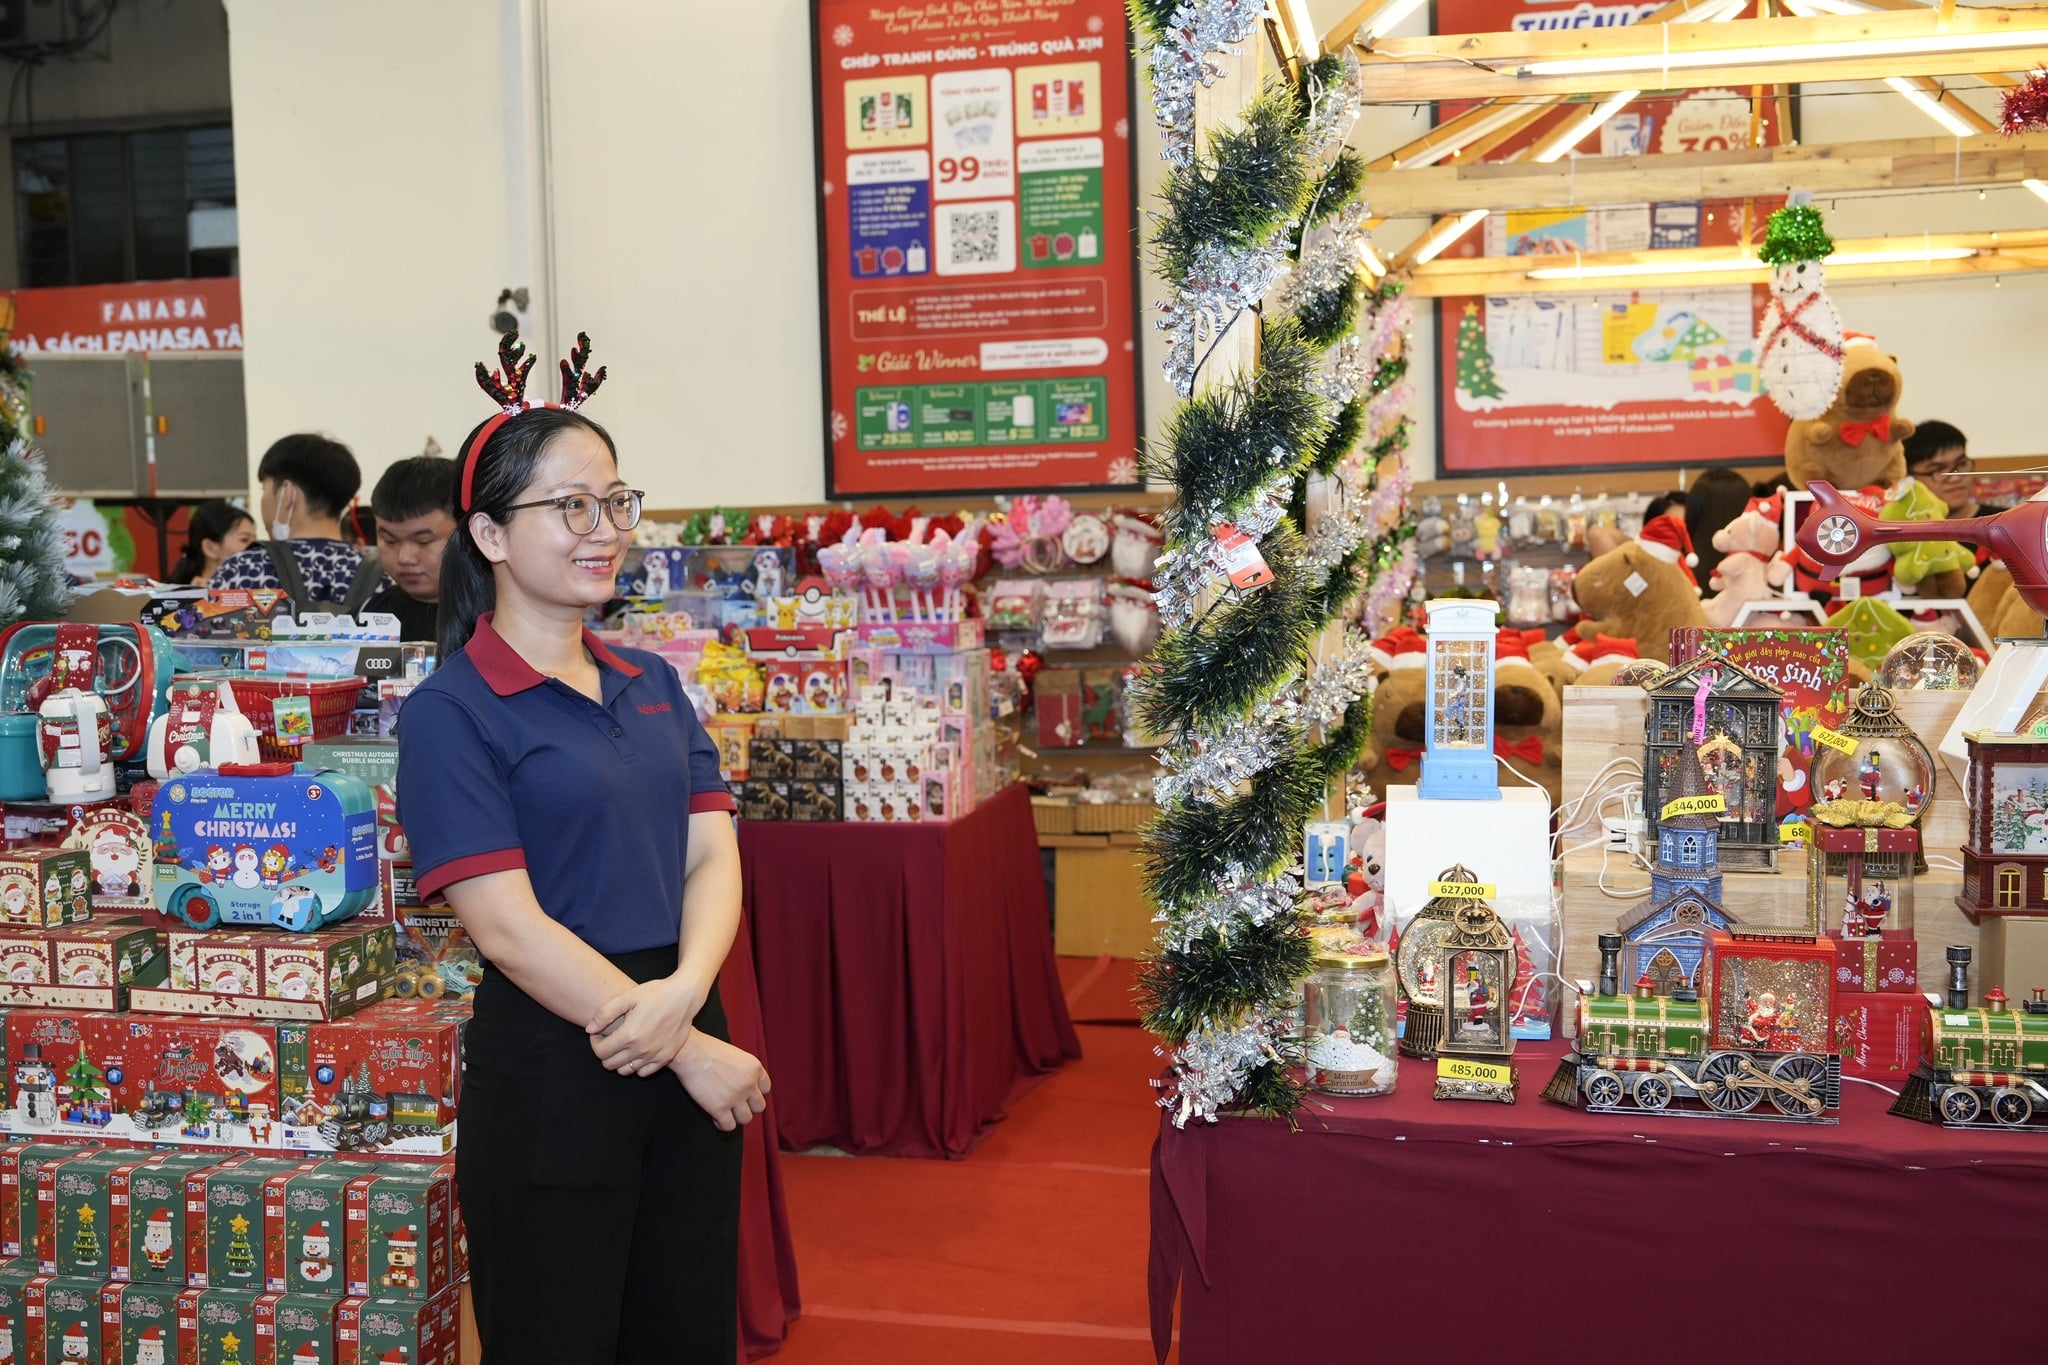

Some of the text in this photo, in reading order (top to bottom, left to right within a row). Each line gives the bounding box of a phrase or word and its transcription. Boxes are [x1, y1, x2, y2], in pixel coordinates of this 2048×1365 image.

[841, 49, 880, 70] GHÉP
[884, 49, 931, 67] TRANH
[934, 45, 977, 63] ĐÚNG
[988, 40, 1039, 58] TRÚNG
[1041, 36, 1074, 56] QUÀ
[1077, 37, 1104, 54] XỊN
[938, 156, 980, 184] 99
[103, 297, 206, 323] FAHASA
[44, 331, 103, 352] SÁCH
[107, 326, 210, 352] FAHASA
[877, 351, 912, 372] Giải
[916, 350, 979, 371] Winner
[250, 656, 266, 666] LEGO
[169, 730, 205, 744] Christmas
[1818, 731, 1848, 748] 627,000
[367, 757, 395, 765] MACHINE
[213, 803, 277, 819] MERRY
[1666, 799, 1718, 815] 1,344,000
[194, 821, 297, 839] CHRISTMAS!
[1440, 885, 1485, 897] 627,000
[230, 901, 261, 910] Storage
[232, 911, 262, 920] 2 in 1
[404, 917, 464, 928] MONSTER
[422, 928, 449, 937] JAM
[1855, 1042, 1870, 1068] Merry
[1334, 1073, 1360, 1081] Merry
[1449, 1064, 1497, 1079] 485,000
